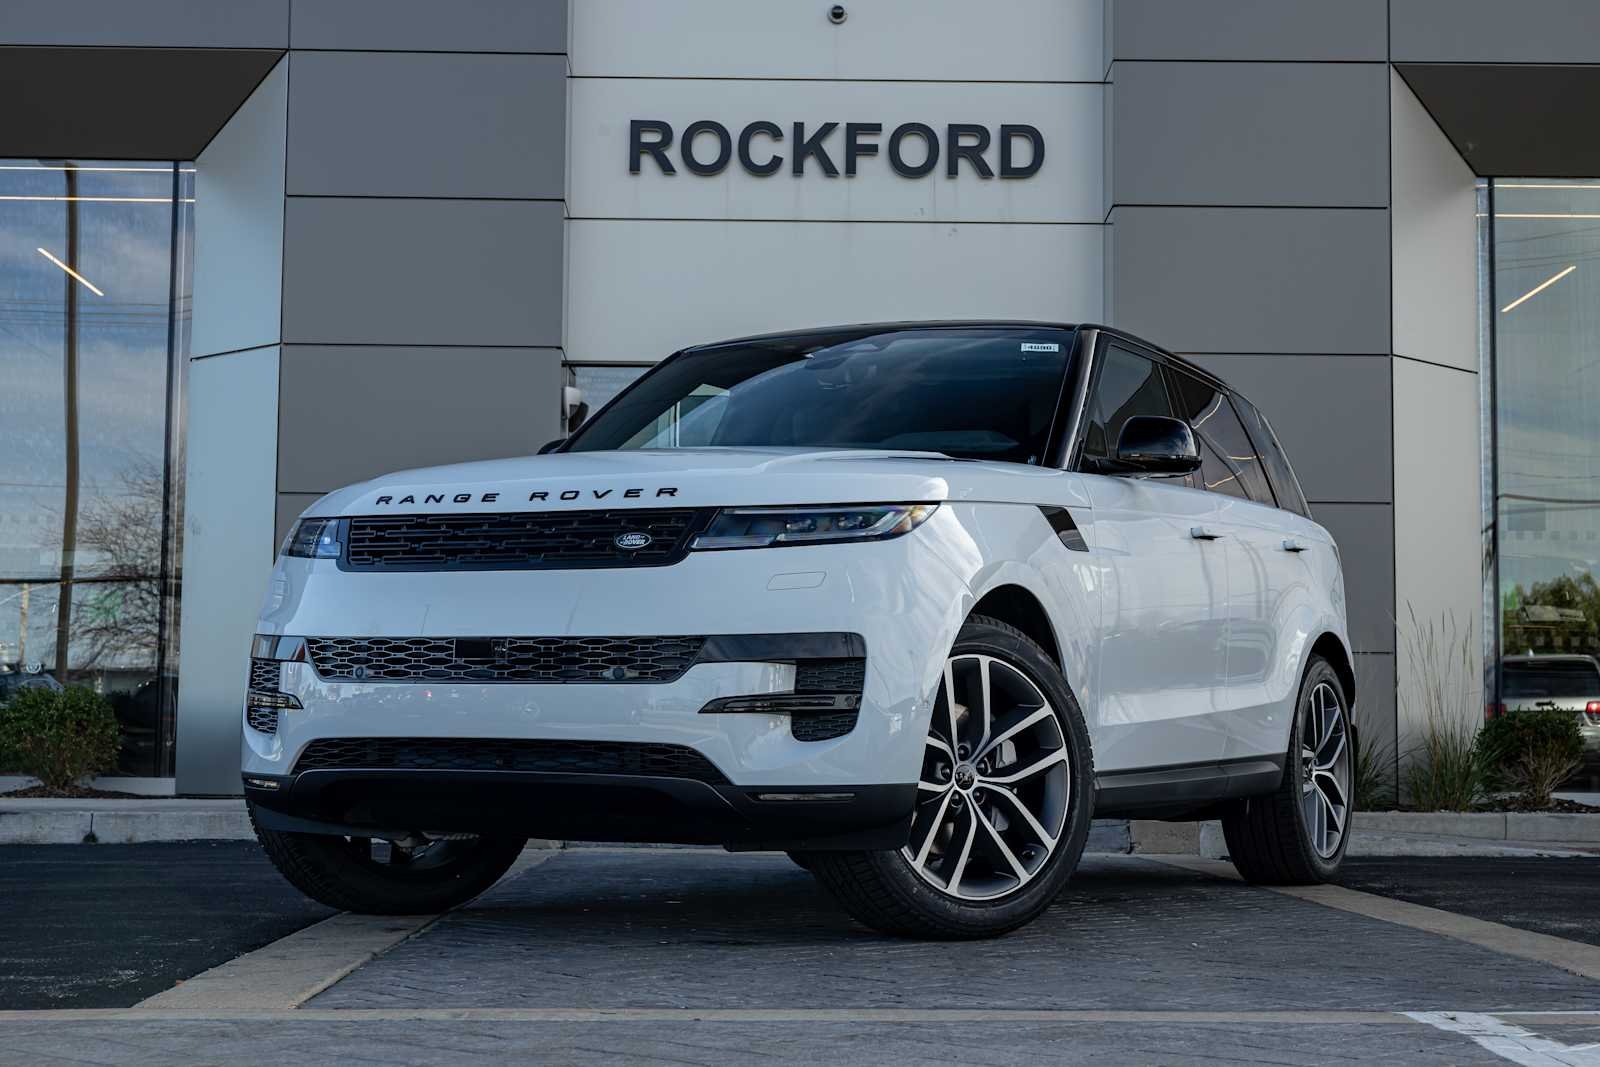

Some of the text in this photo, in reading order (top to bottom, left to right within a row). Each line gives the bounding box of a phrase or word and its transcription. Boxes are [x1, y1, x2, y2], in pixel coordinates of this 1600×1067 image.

[629, 119, 1046, 179] ROCKFORD
[375, 487, 679, 505] RANGE ROVER
